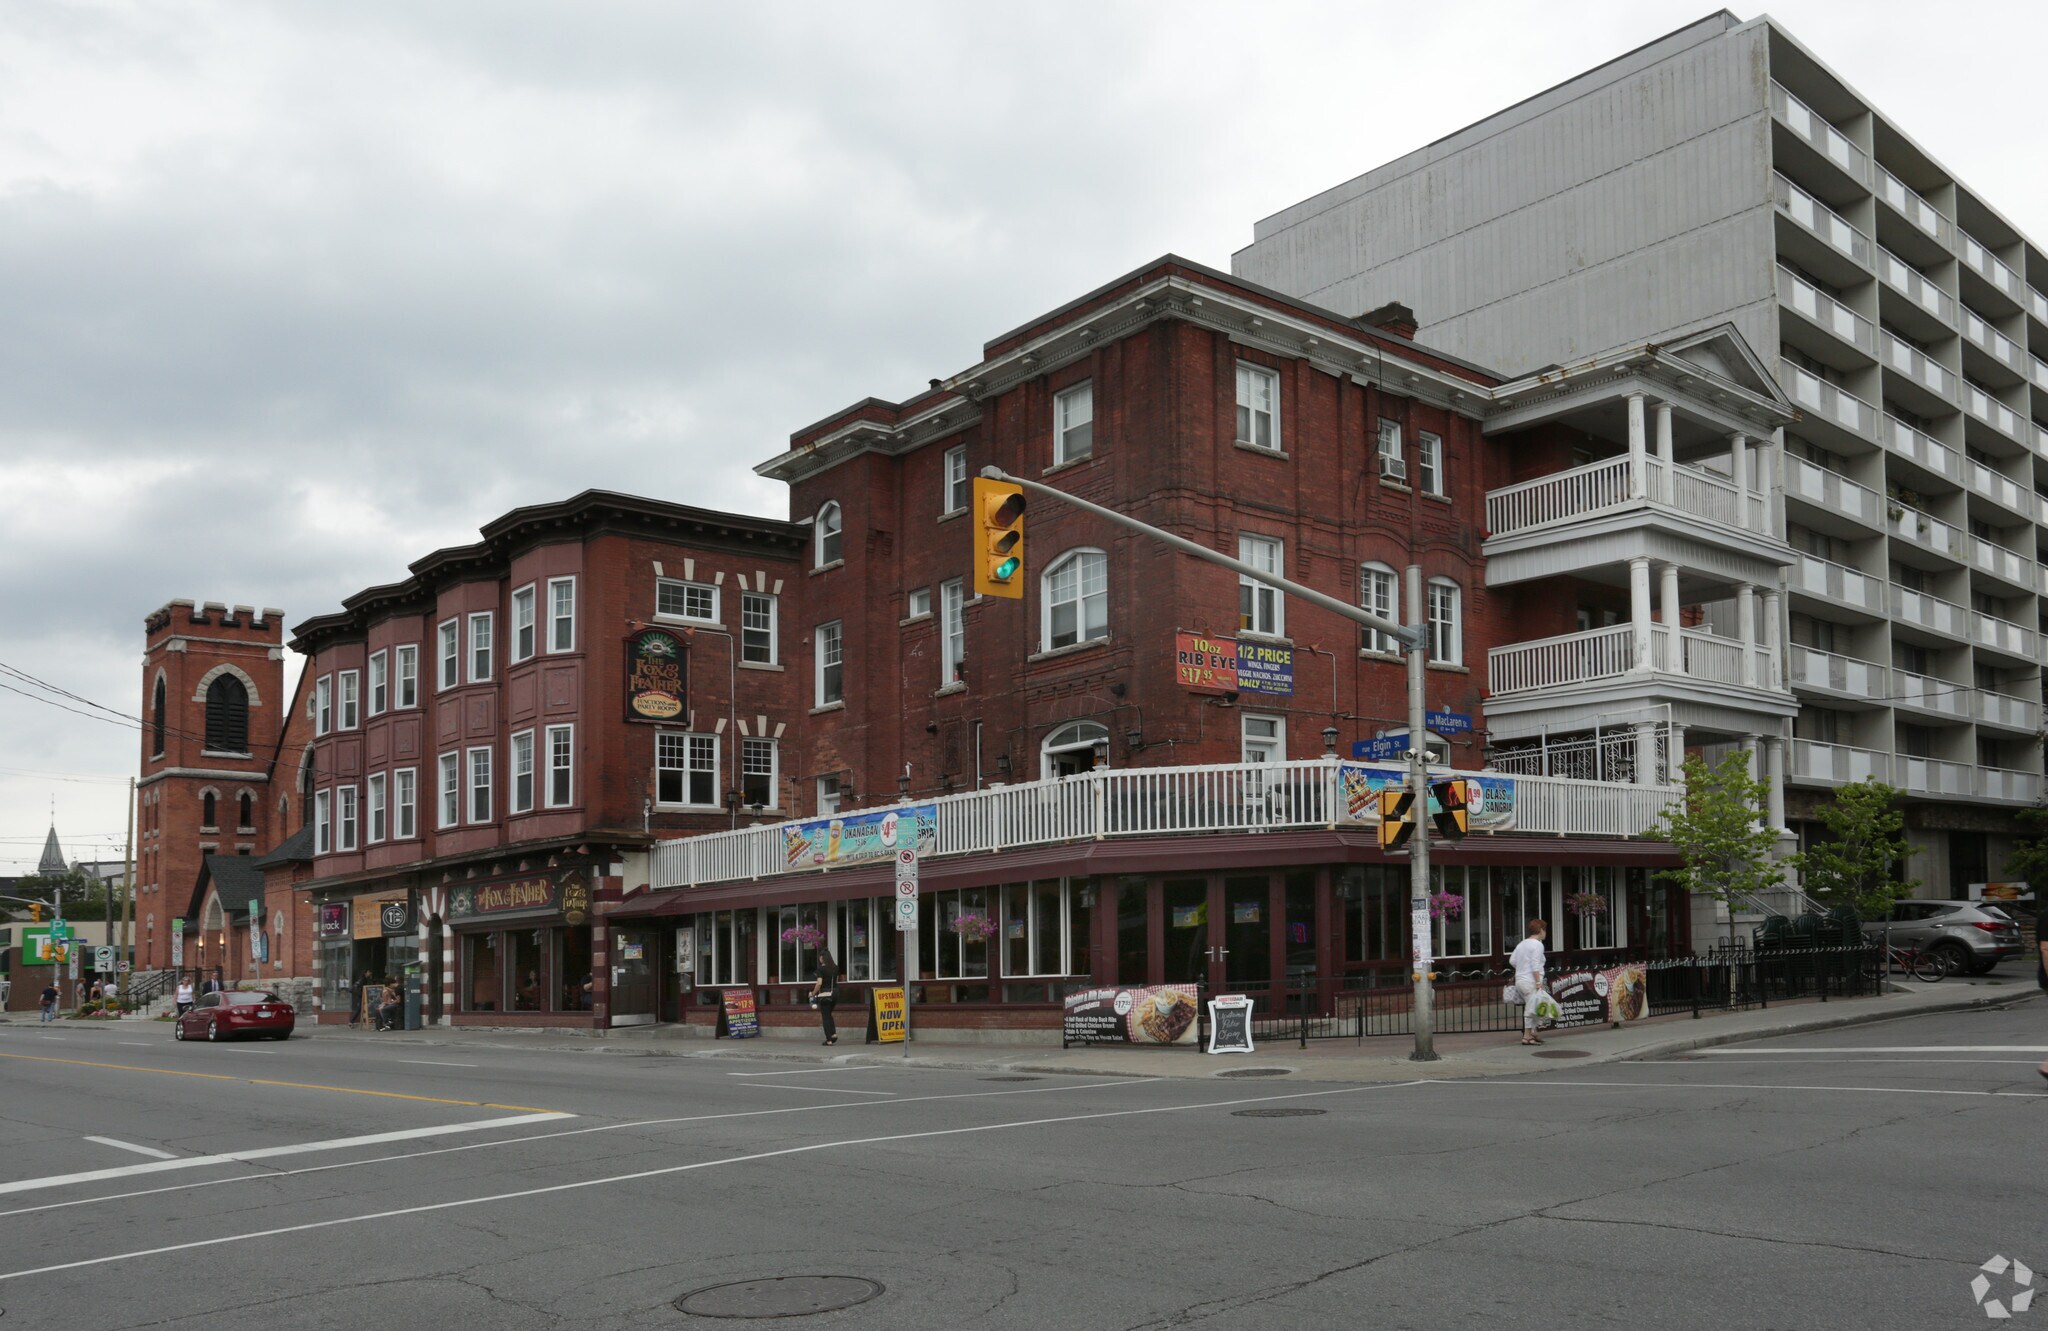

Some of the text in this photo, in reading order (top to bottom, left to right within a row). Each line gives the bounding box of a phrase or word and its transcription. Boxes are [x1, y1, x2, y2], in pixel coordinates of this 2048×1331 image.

[1237, 645, 1291, 664] 1/2 PRICE
[1178, 651, 1236, 671] RIB EYE
[636, 659, 665, 676] FOX
[629, 674, 685, 694] FEATHER
[1238, 678, 1260, 689] DAILY
[1435, 716, 1462, 728] MacLaren
[1373, 740, 1391, 753] Elgin
[1485, 789, 1507, 800] GLASS
[1485, 802, 1513, 813] SANGRIA
[844, 826, 879, 840] OKANAGAN
[484, 887, 503, 910] FOX
[510, 879, 548, 907] FEATHER
[877, 991, 904, 1000] UPSTAIRS
[884, 1001, 900, 1009] PATIO
[880, 1009, 902, 1020] NOW
[882, 1021, 906, 1031] OPEN
